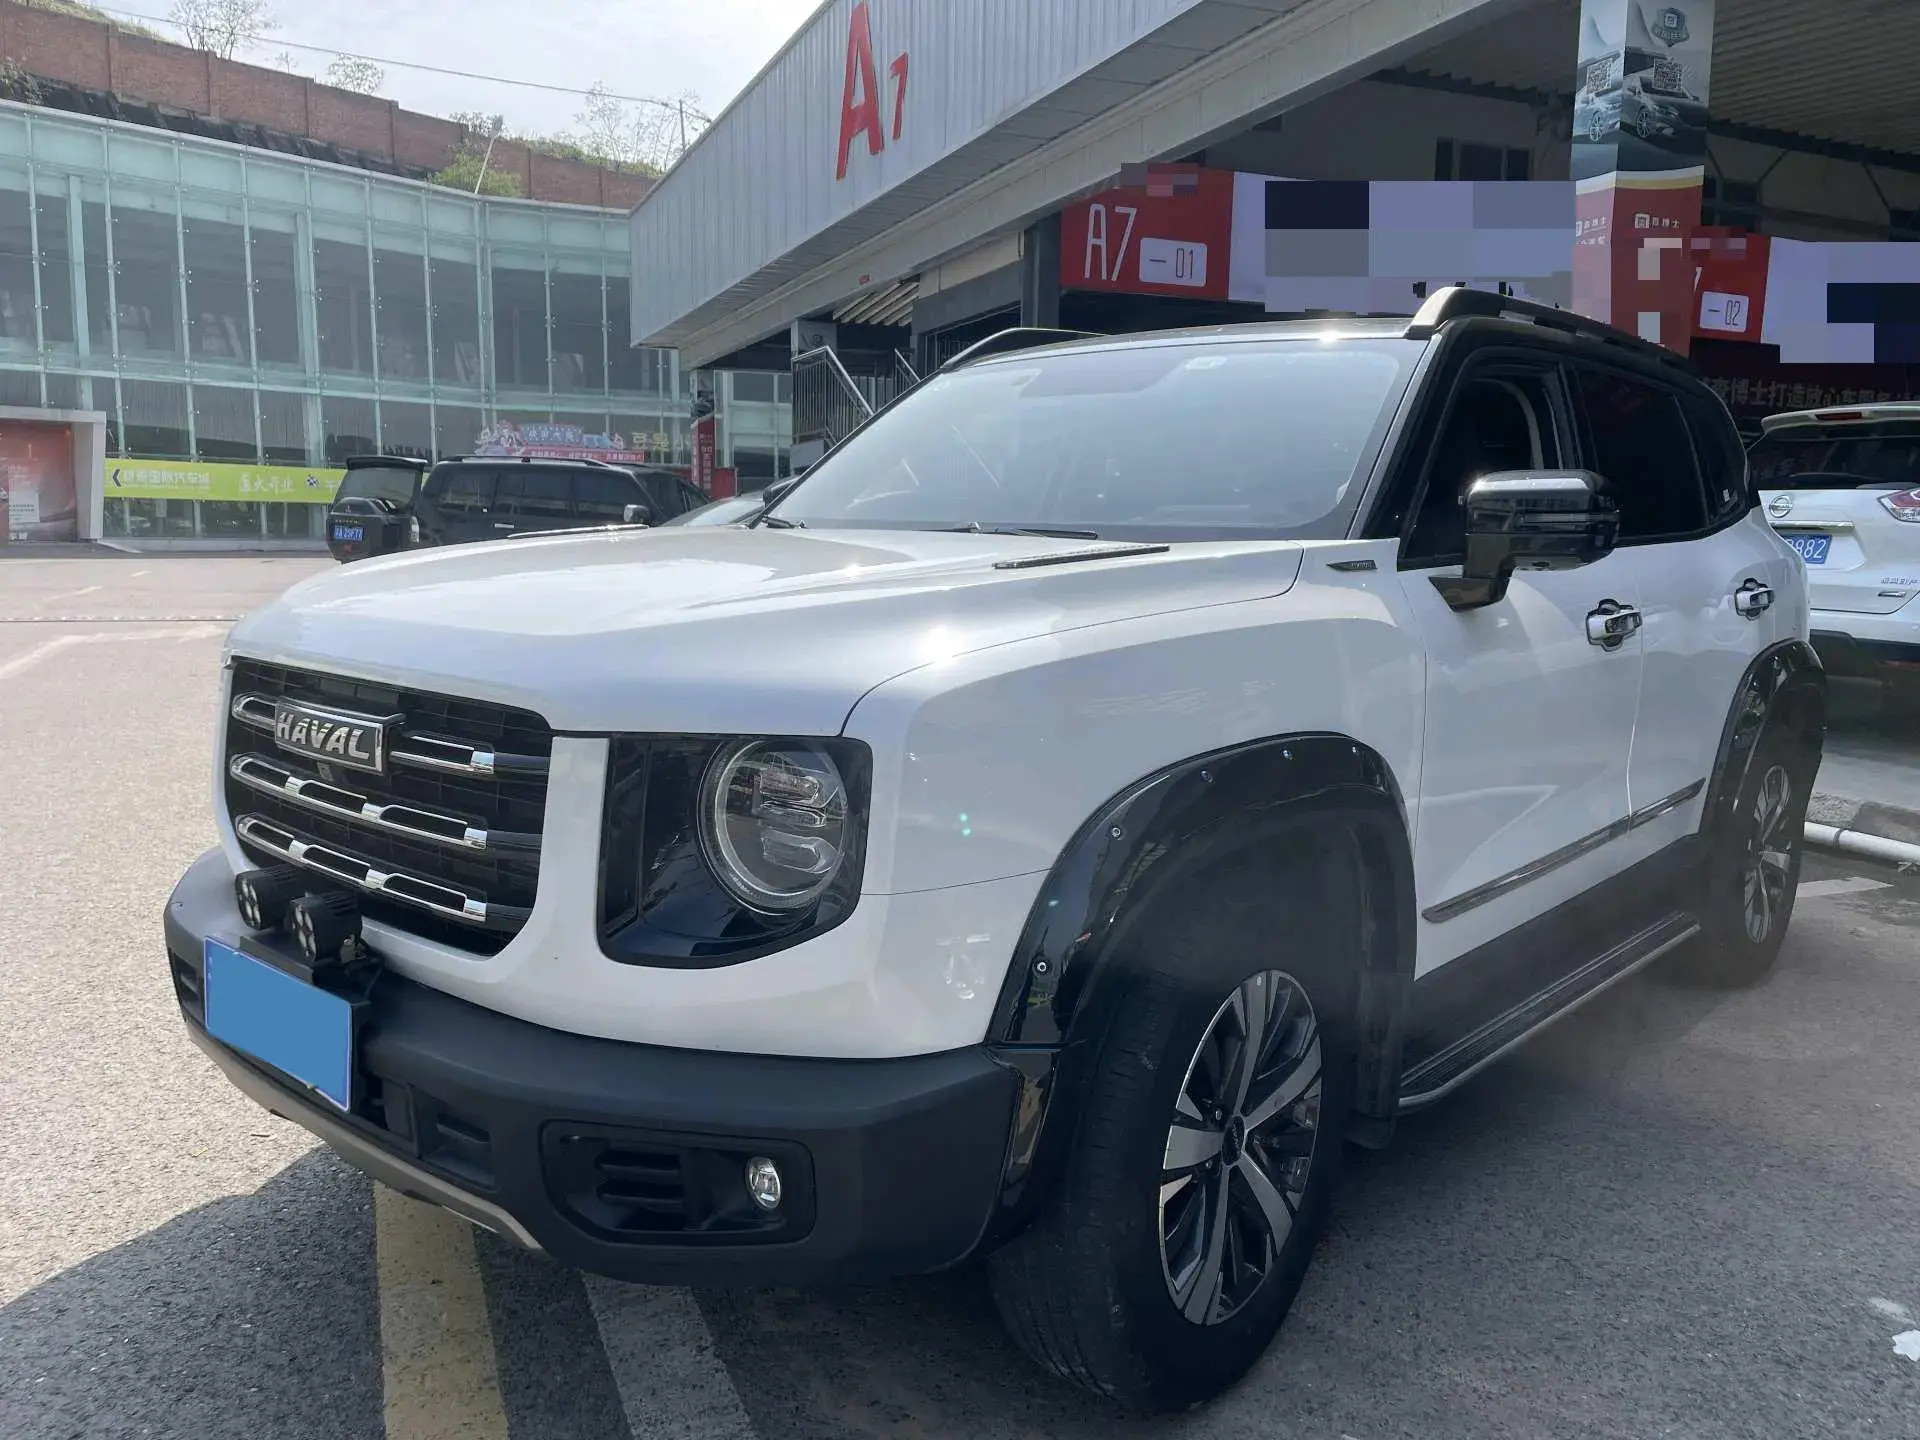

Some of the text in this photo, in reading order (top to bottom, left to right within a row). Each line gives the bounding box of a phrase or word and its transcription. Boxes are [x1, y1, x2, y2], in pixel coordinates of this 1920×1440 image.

[836, 1, 909, 181] A1
[1084, 203, 1137, 282] A7
[275, 711, 370, 760] HAVAL
